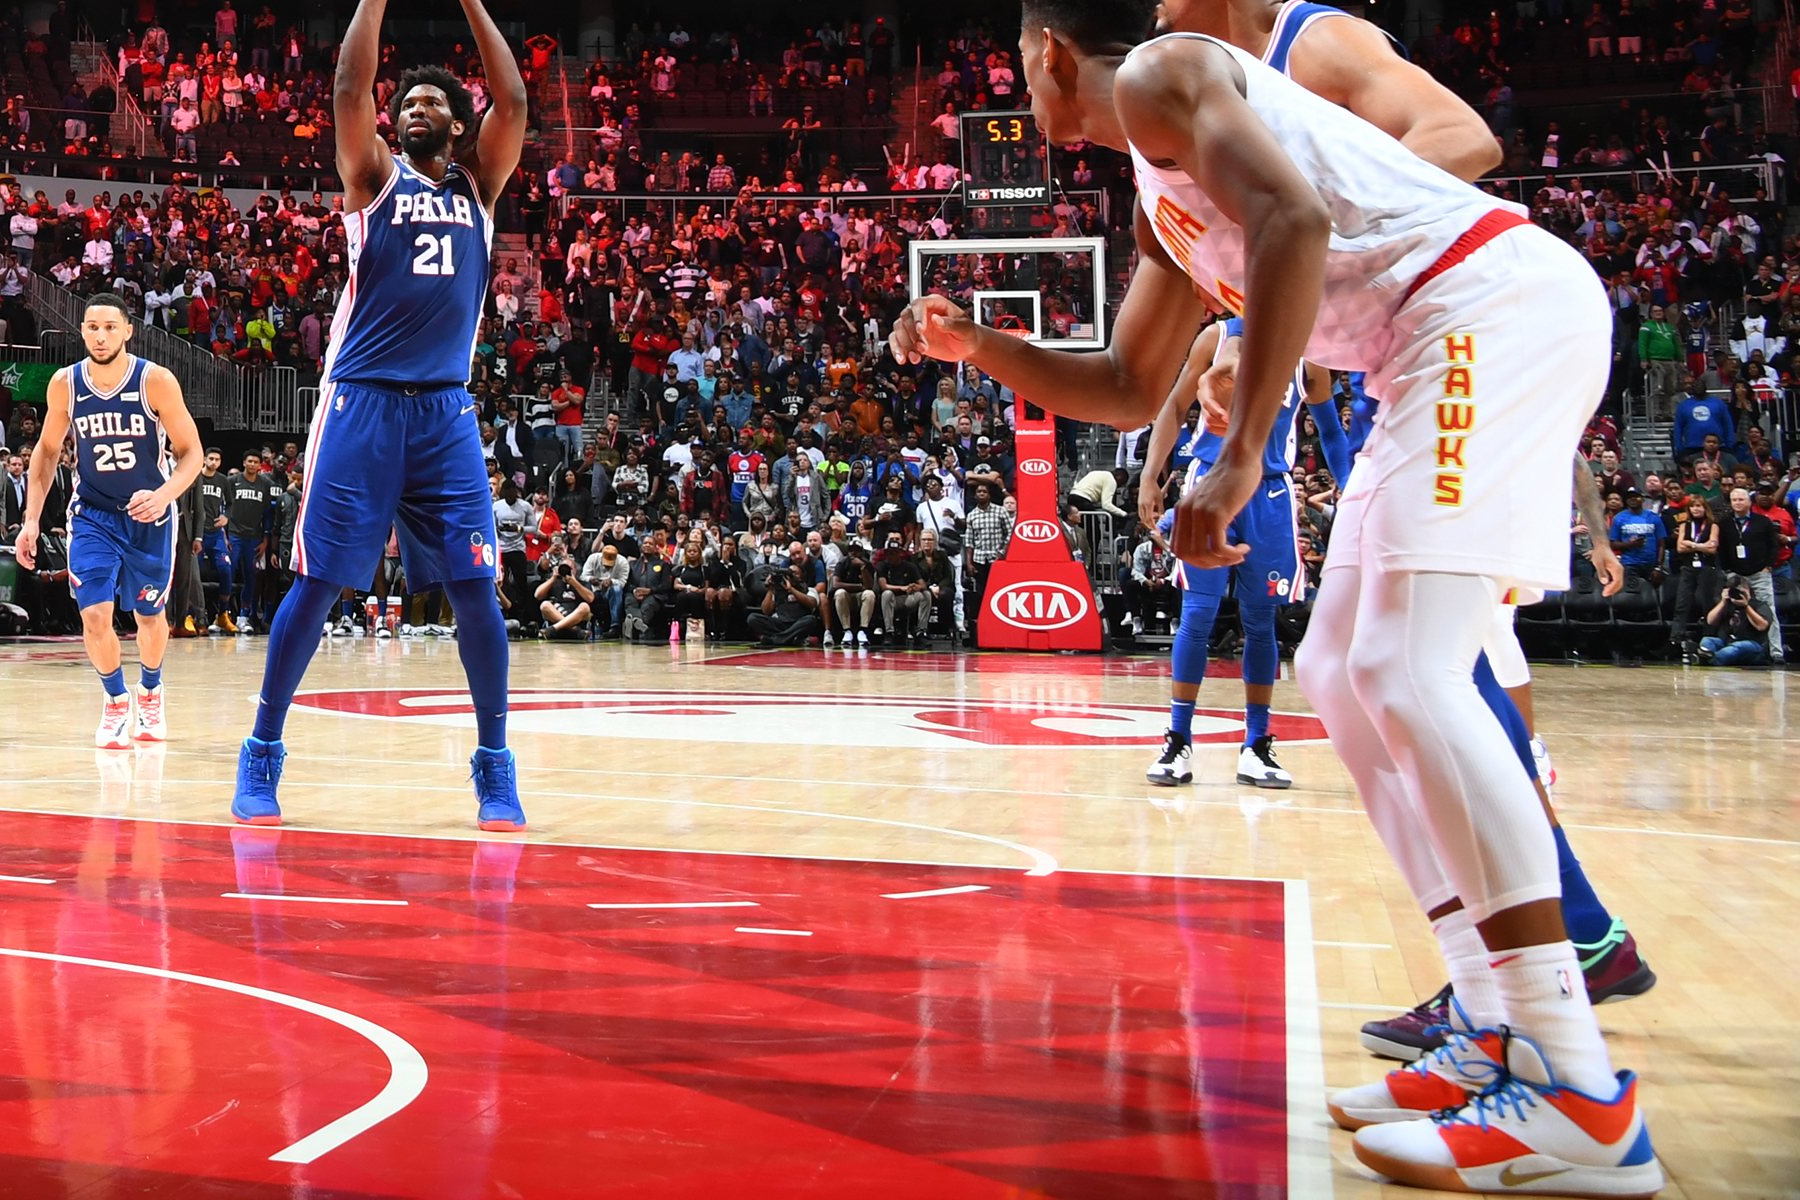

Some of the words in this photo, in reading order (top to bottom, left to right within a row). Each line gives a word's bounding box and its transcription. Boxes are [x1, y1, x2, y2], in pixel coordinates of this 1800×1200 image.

[987, 119, 1022, 142] 5.3
[989, 187, 1045, 200] TISSOT
[412, 233, 455, 276] 21
[74, 411, 147, 439] PHILA
[1433, 333, 1476, 507] HAWKS
[93, 441, 137, 472] 25
[1025, 462, 1047, 472] KIA
[235, 489, 263, 502] PHILA
[846, 503, 865, 517] 30
[1022, 525, 1052, 538] KIA
[470, 543, 494, 567] 76
[1267, 578, 1290, 596] 76
[1006, 592, 1072, 619] KIA
